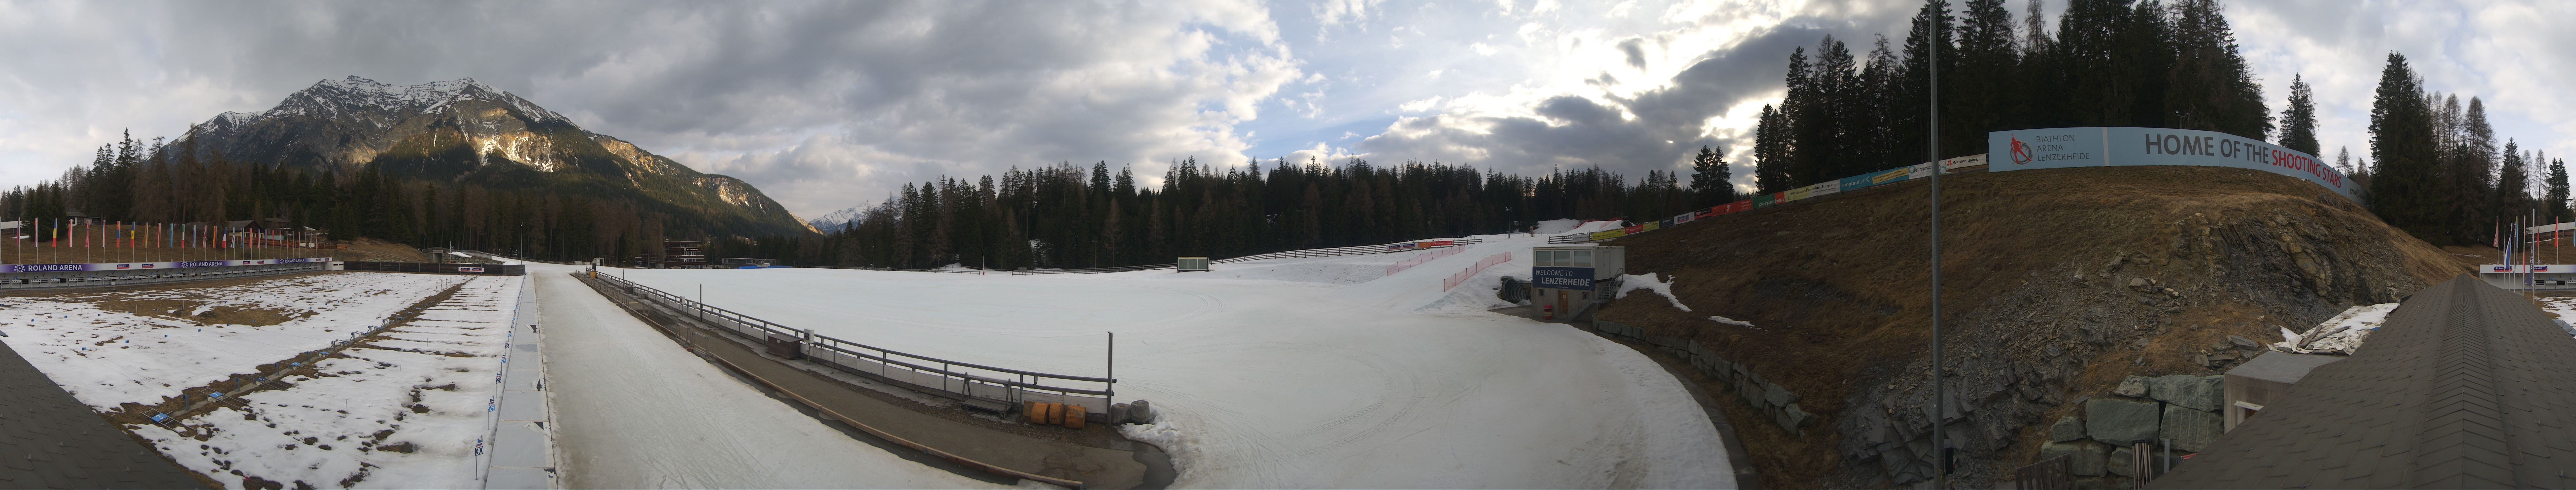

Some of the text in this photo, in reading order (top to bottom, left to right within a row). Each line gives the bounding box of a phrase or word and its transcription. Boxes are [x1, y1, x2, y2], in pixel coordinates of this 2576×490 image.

[2038, 153, 2089, 161] LENZERHEIDE
[2146, 134, 2341, 188] HOME OF THE SHOOTING STARS
[1842, 179, 1865, 187] langlauf.ch
[1759, 198, 1784, 207] parpanbau
[1541, 277, 1590, 286] LENZERHEIDE
[476, 446, 483, 455] 30
